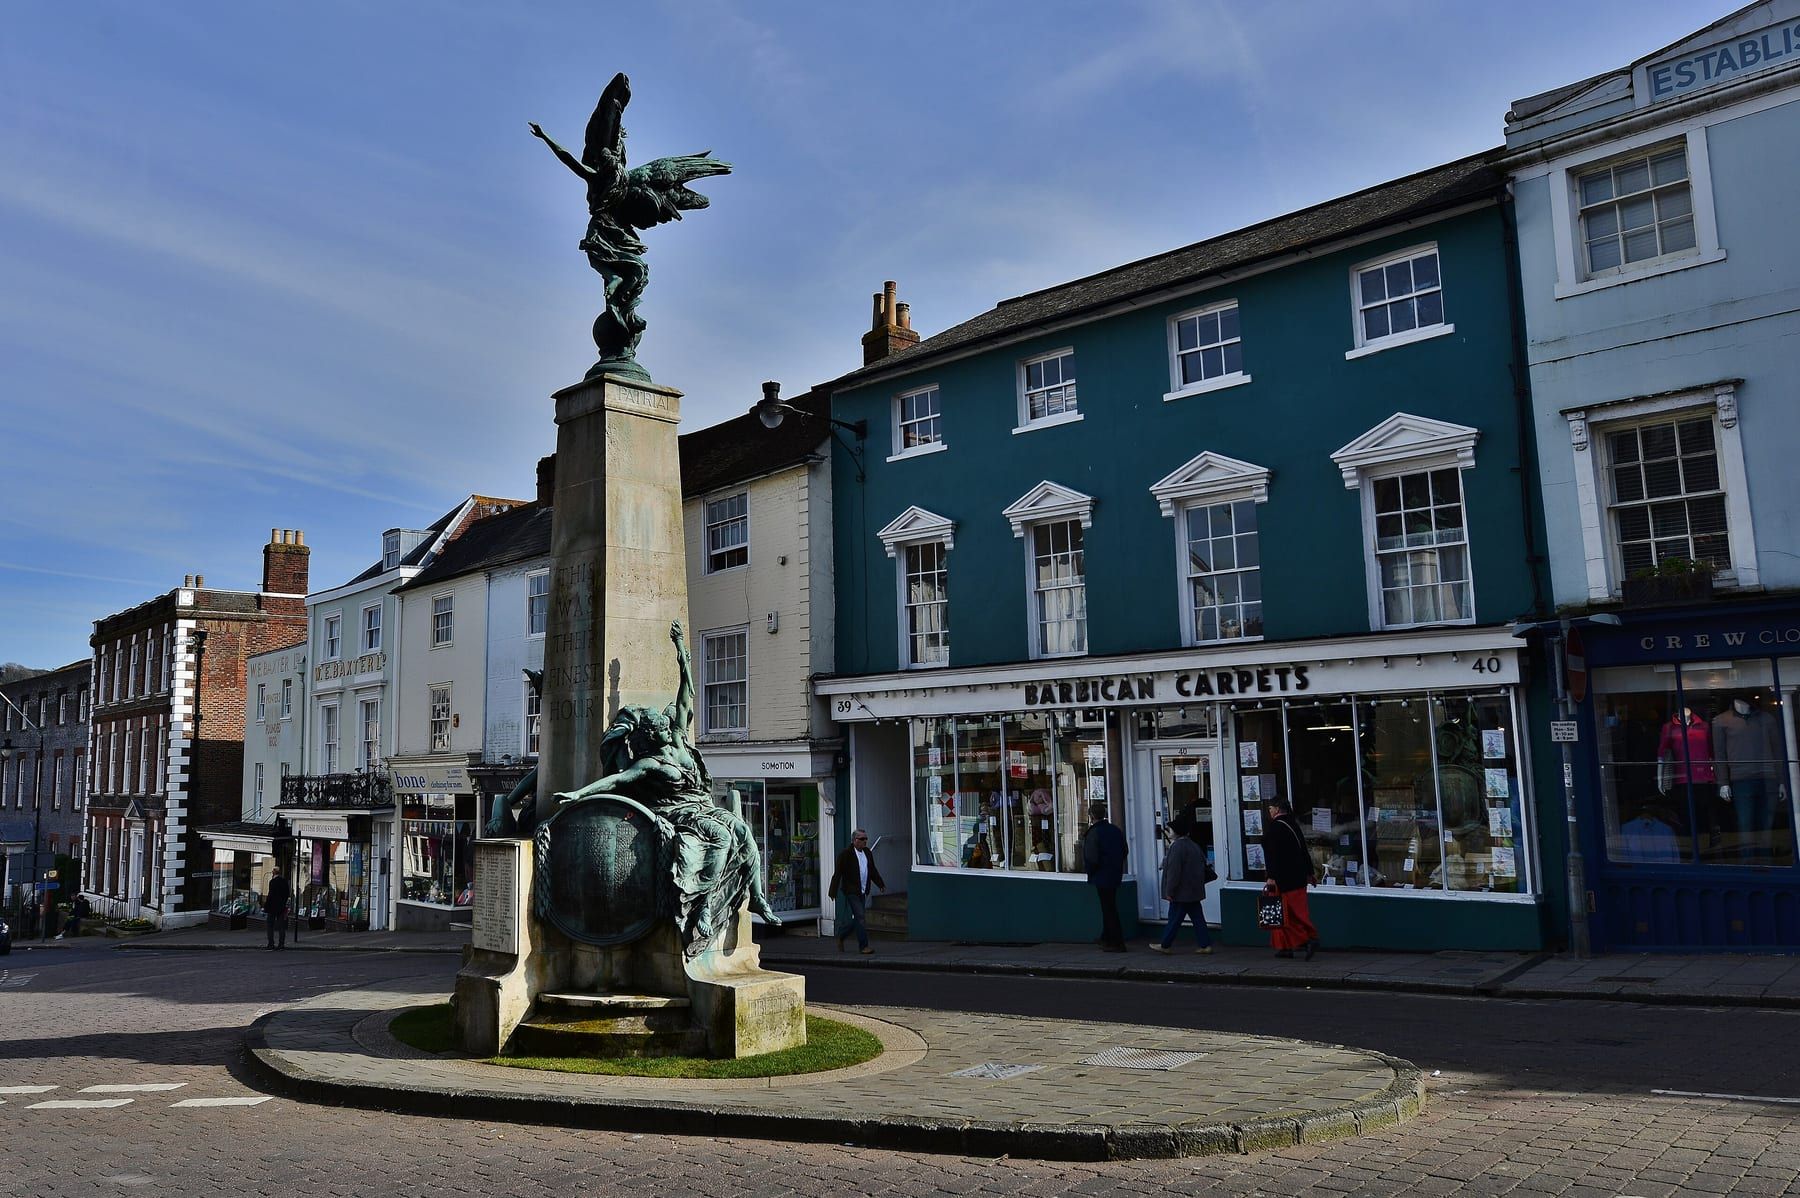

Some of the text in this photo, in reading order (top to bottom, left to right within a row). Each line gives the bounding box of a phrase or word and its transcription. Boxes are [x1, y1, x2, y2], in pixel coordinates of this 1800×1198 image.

[1640, 631, 1746, 651] CREW
[1472, 657, 1500, 674] 40
[549, 663, 600, 689] FINEST
[1025, 666, 1310, 706] BARBICAN CARPETS
[837, 700, 852, 713] 39
[1178, 747, 1188, 755] 40
[394, 771, 426, 789] bone
